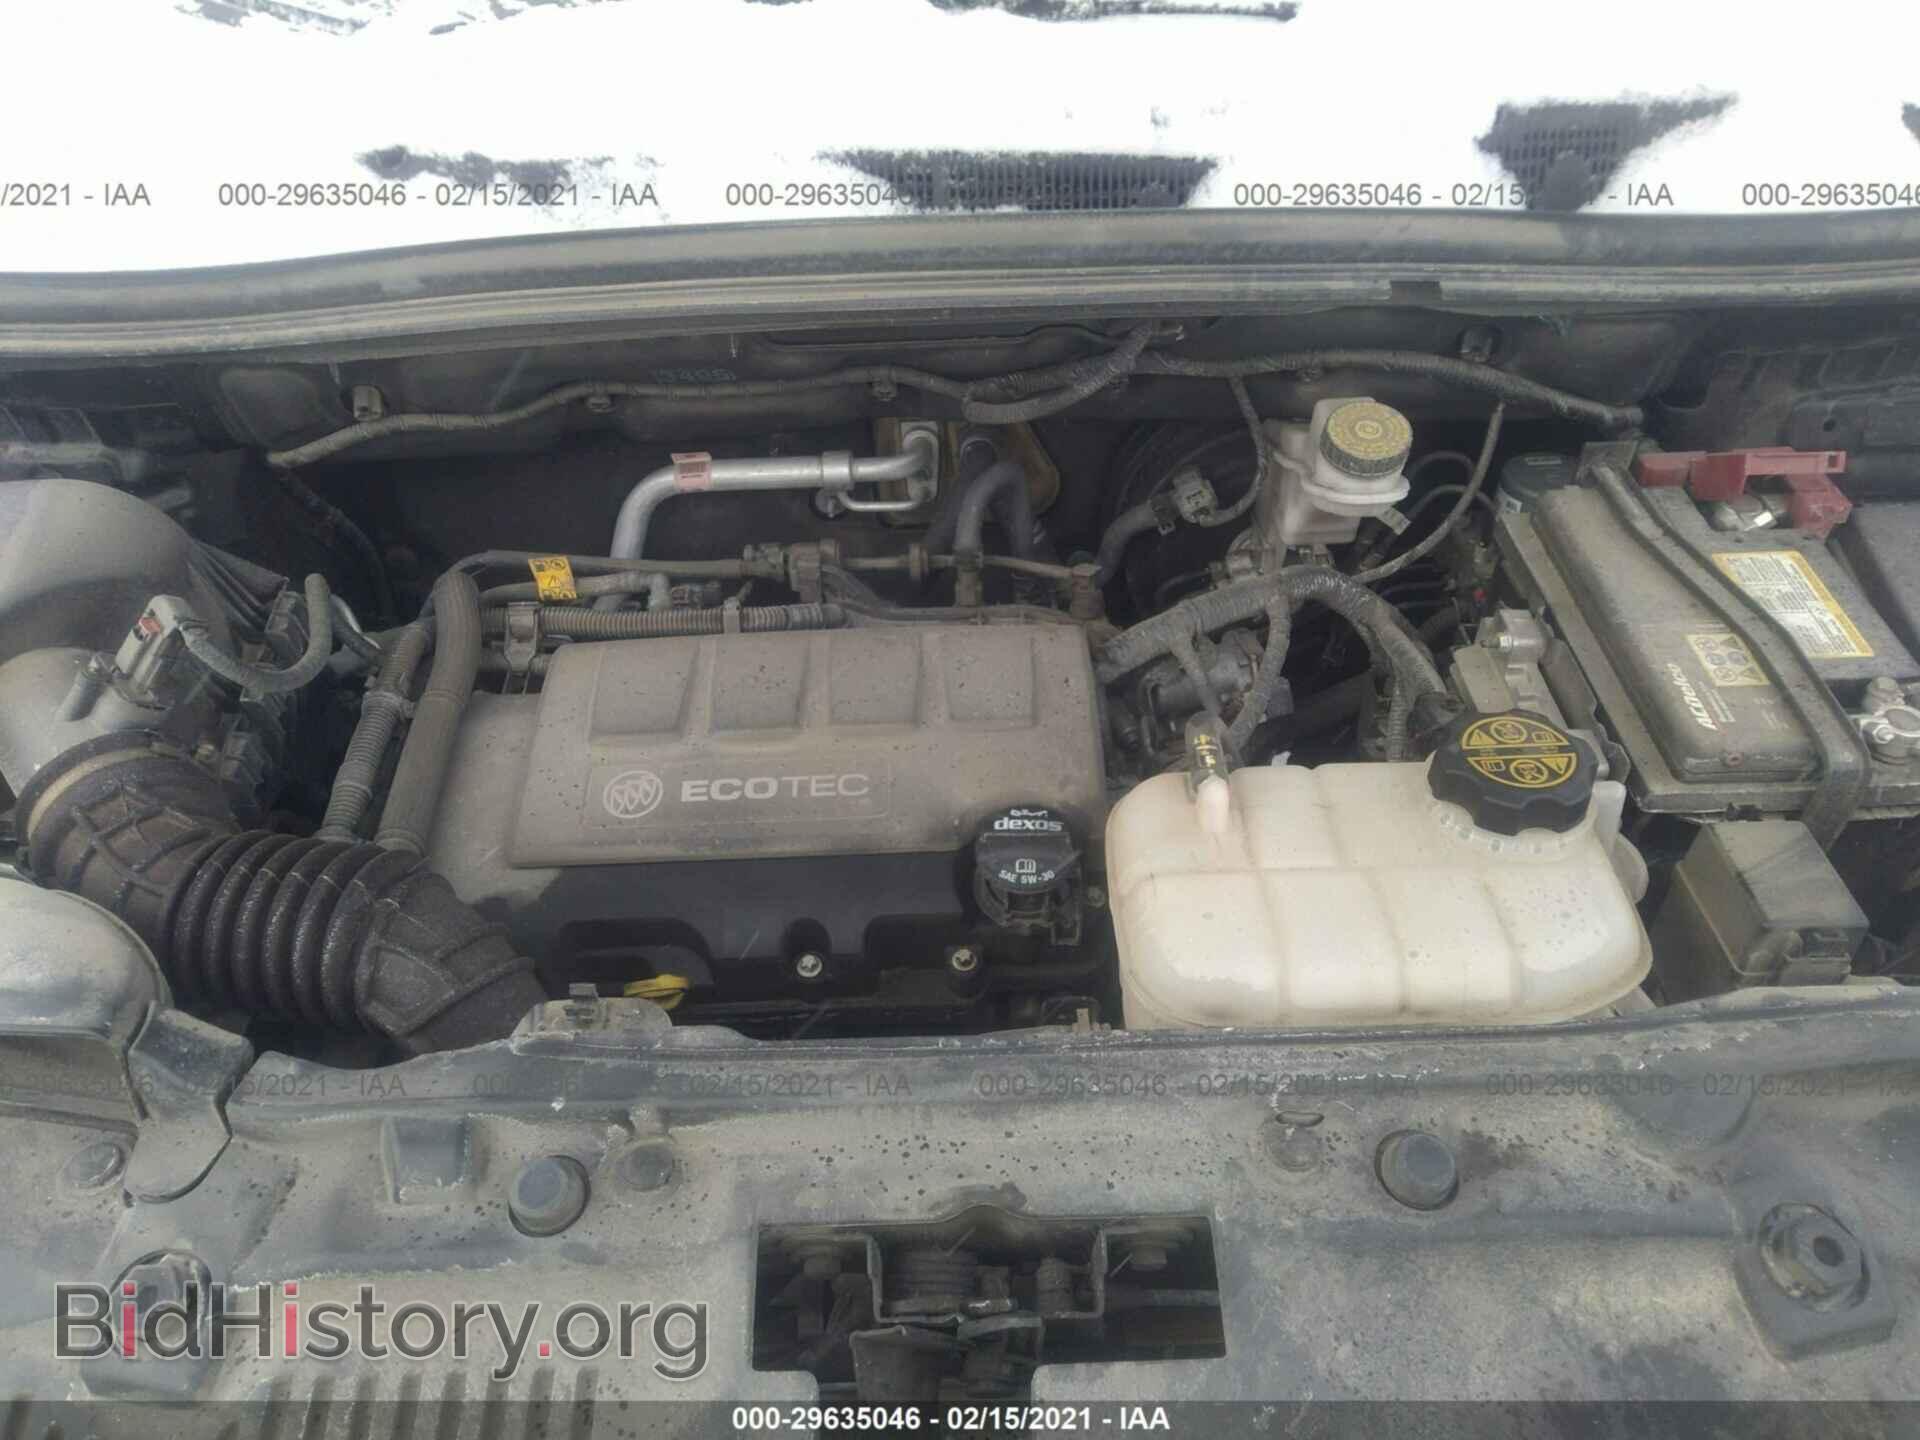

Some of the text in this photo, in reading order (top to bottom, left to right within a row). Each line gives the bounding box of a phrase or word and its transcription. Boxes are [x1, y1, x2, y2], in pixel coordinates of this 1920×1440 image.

[680, 773, 870, 802] ECOTEC
[994, 817, 1063, 832] dexos
[998, 869, 1056, 885] SAE 5W-30
